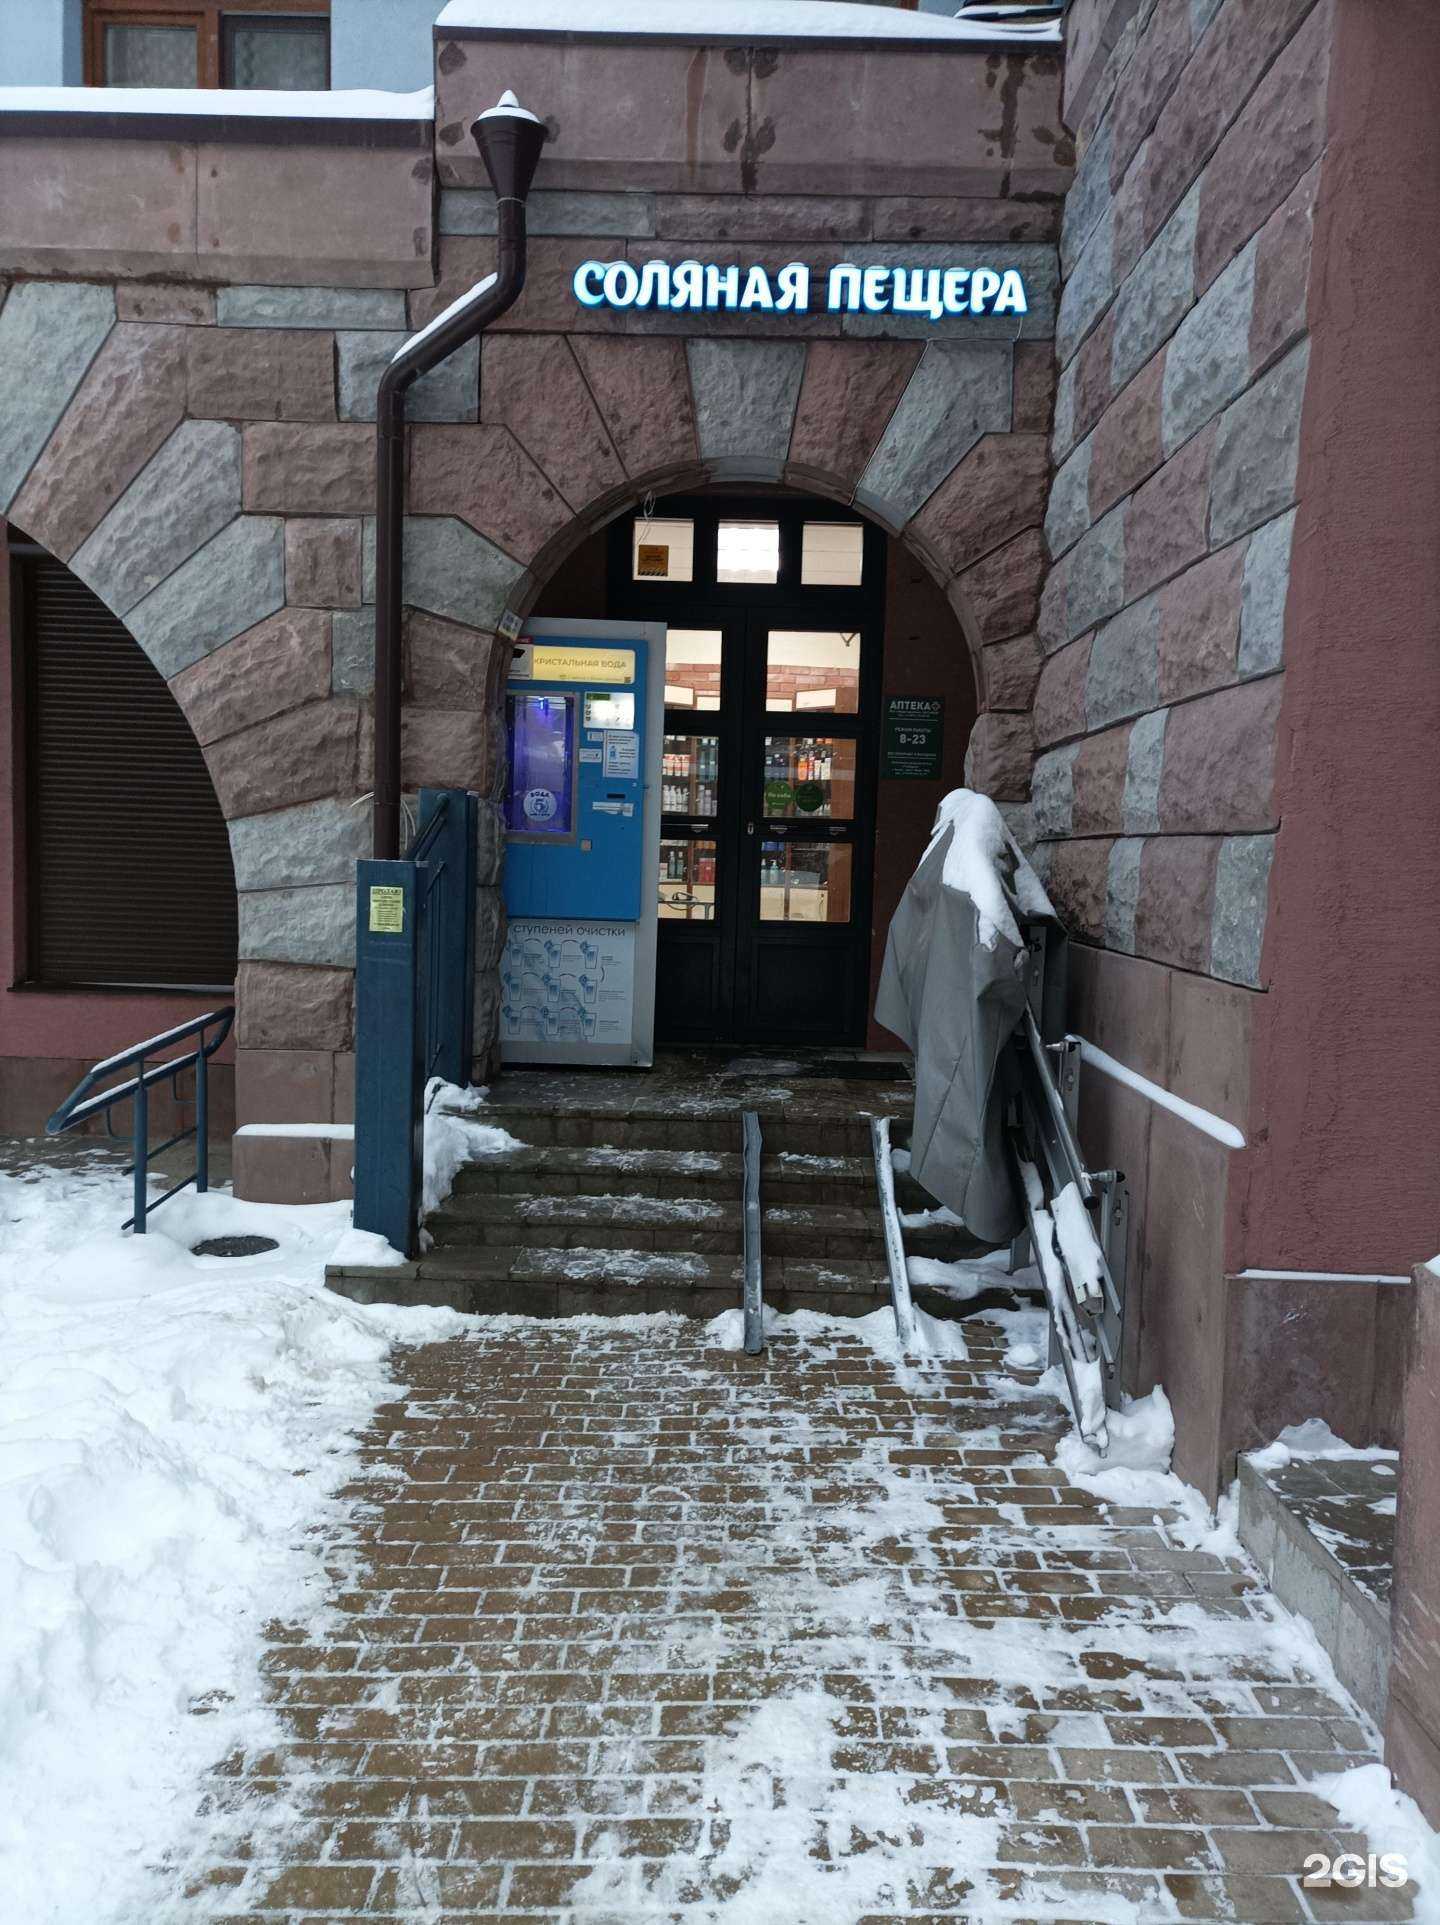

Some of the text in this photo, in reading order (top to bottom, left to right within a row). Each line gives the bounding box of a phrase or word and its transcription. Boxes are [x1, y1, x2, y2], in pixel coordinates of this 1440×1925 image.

[573, 260, 1028, 320] СОЛЯНАЯ ПЕЩЕРА
[600, 660, 627, 669] ВОДА
[889, 700, 932, 710] АПТЕКА
[899, 733, 927, 745] 8-23
[513, 924, 626, 937] ступеней очистки
